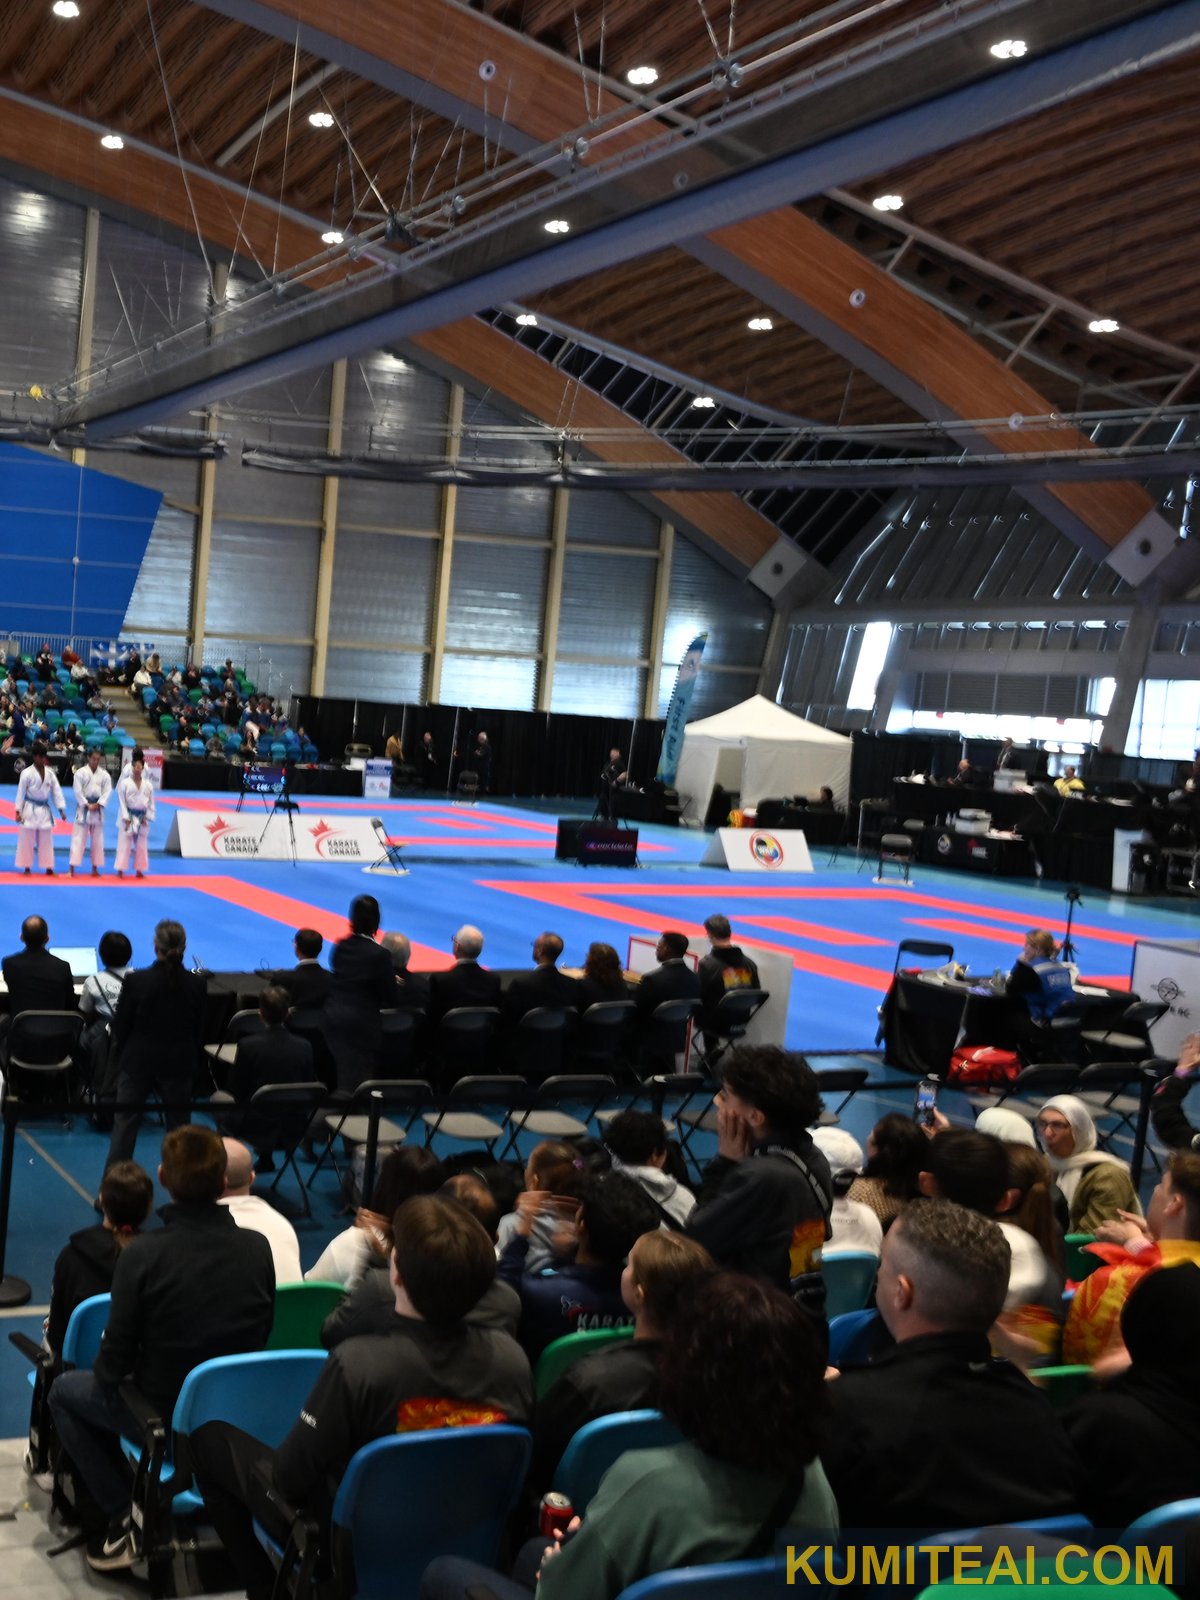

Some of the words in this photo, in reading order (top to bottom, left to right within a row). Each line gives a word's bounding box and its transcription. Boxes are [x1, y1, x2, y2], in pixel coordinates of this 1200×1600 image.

[223, 836, 257, 846] KARATE
[327, 839, 358, 848] KARATE
[225, 844, 259, 854] CANADA
[328, 847, 361, 856] CANADA
